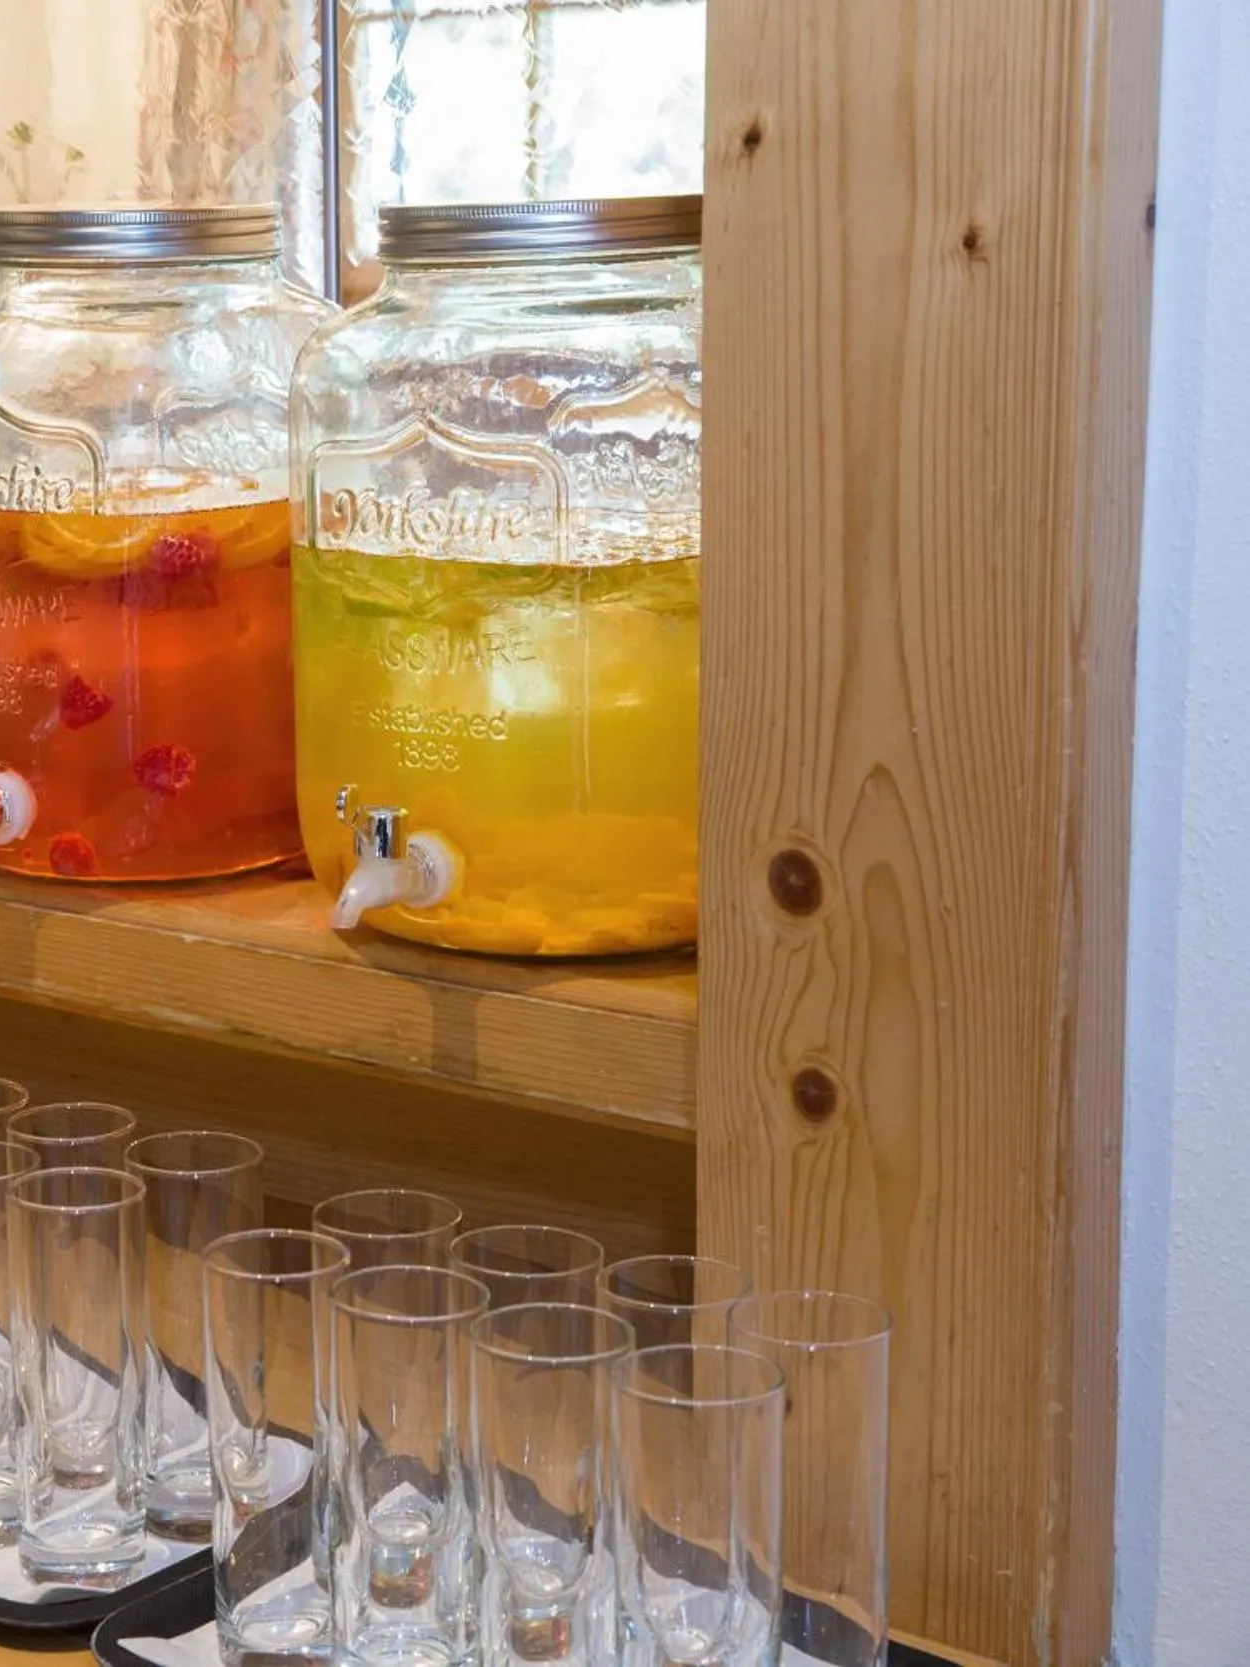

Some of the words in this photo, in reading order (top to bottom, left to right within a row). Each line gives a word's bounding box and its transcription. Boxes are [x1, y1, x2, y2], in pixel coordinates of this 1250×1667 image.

[330, 484, 530, 544] Yorkshire
[352, 698, 509, 742] Established
[392, 739, 464, 773] 1898
